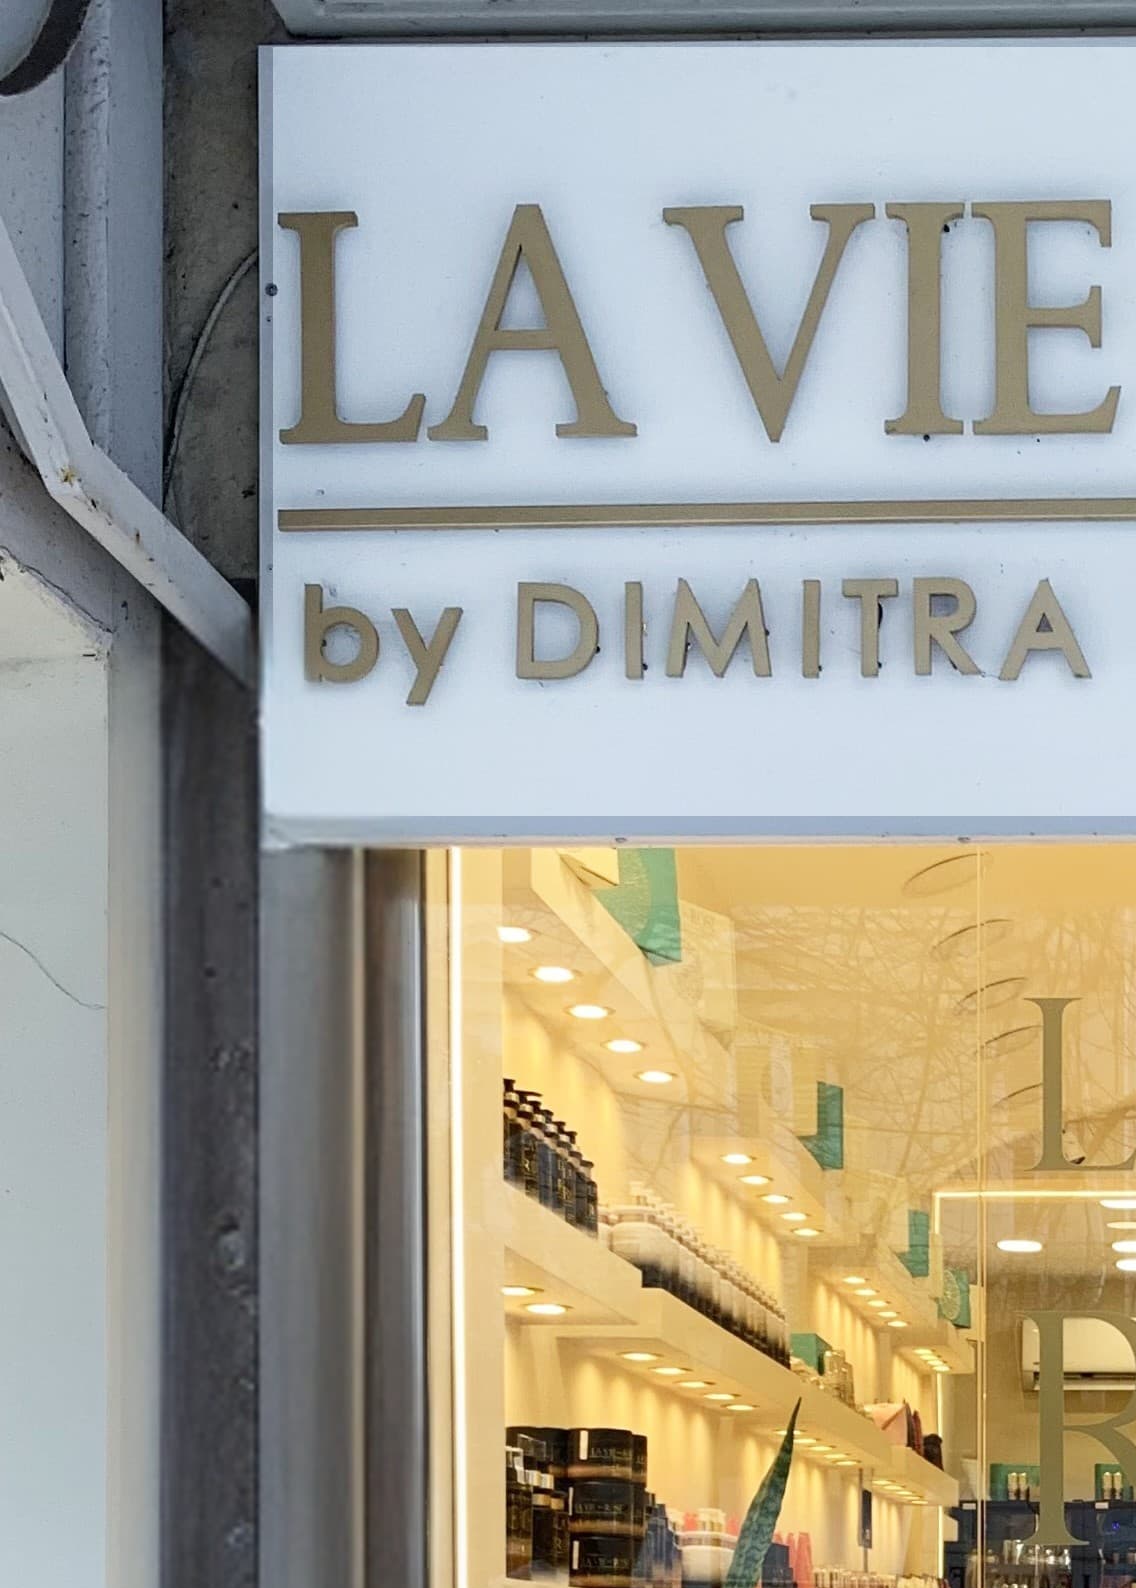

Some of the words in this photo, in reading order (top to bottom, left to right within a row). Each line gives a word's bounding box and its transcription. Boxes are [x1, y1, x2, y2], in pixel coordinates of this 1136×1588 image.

[277, 204, 637, 444] LA
[662, 200, 1121, 443] VIE
[304, 582, 463, 706] by
[516, 576, 1092, 682] DIMITRA
